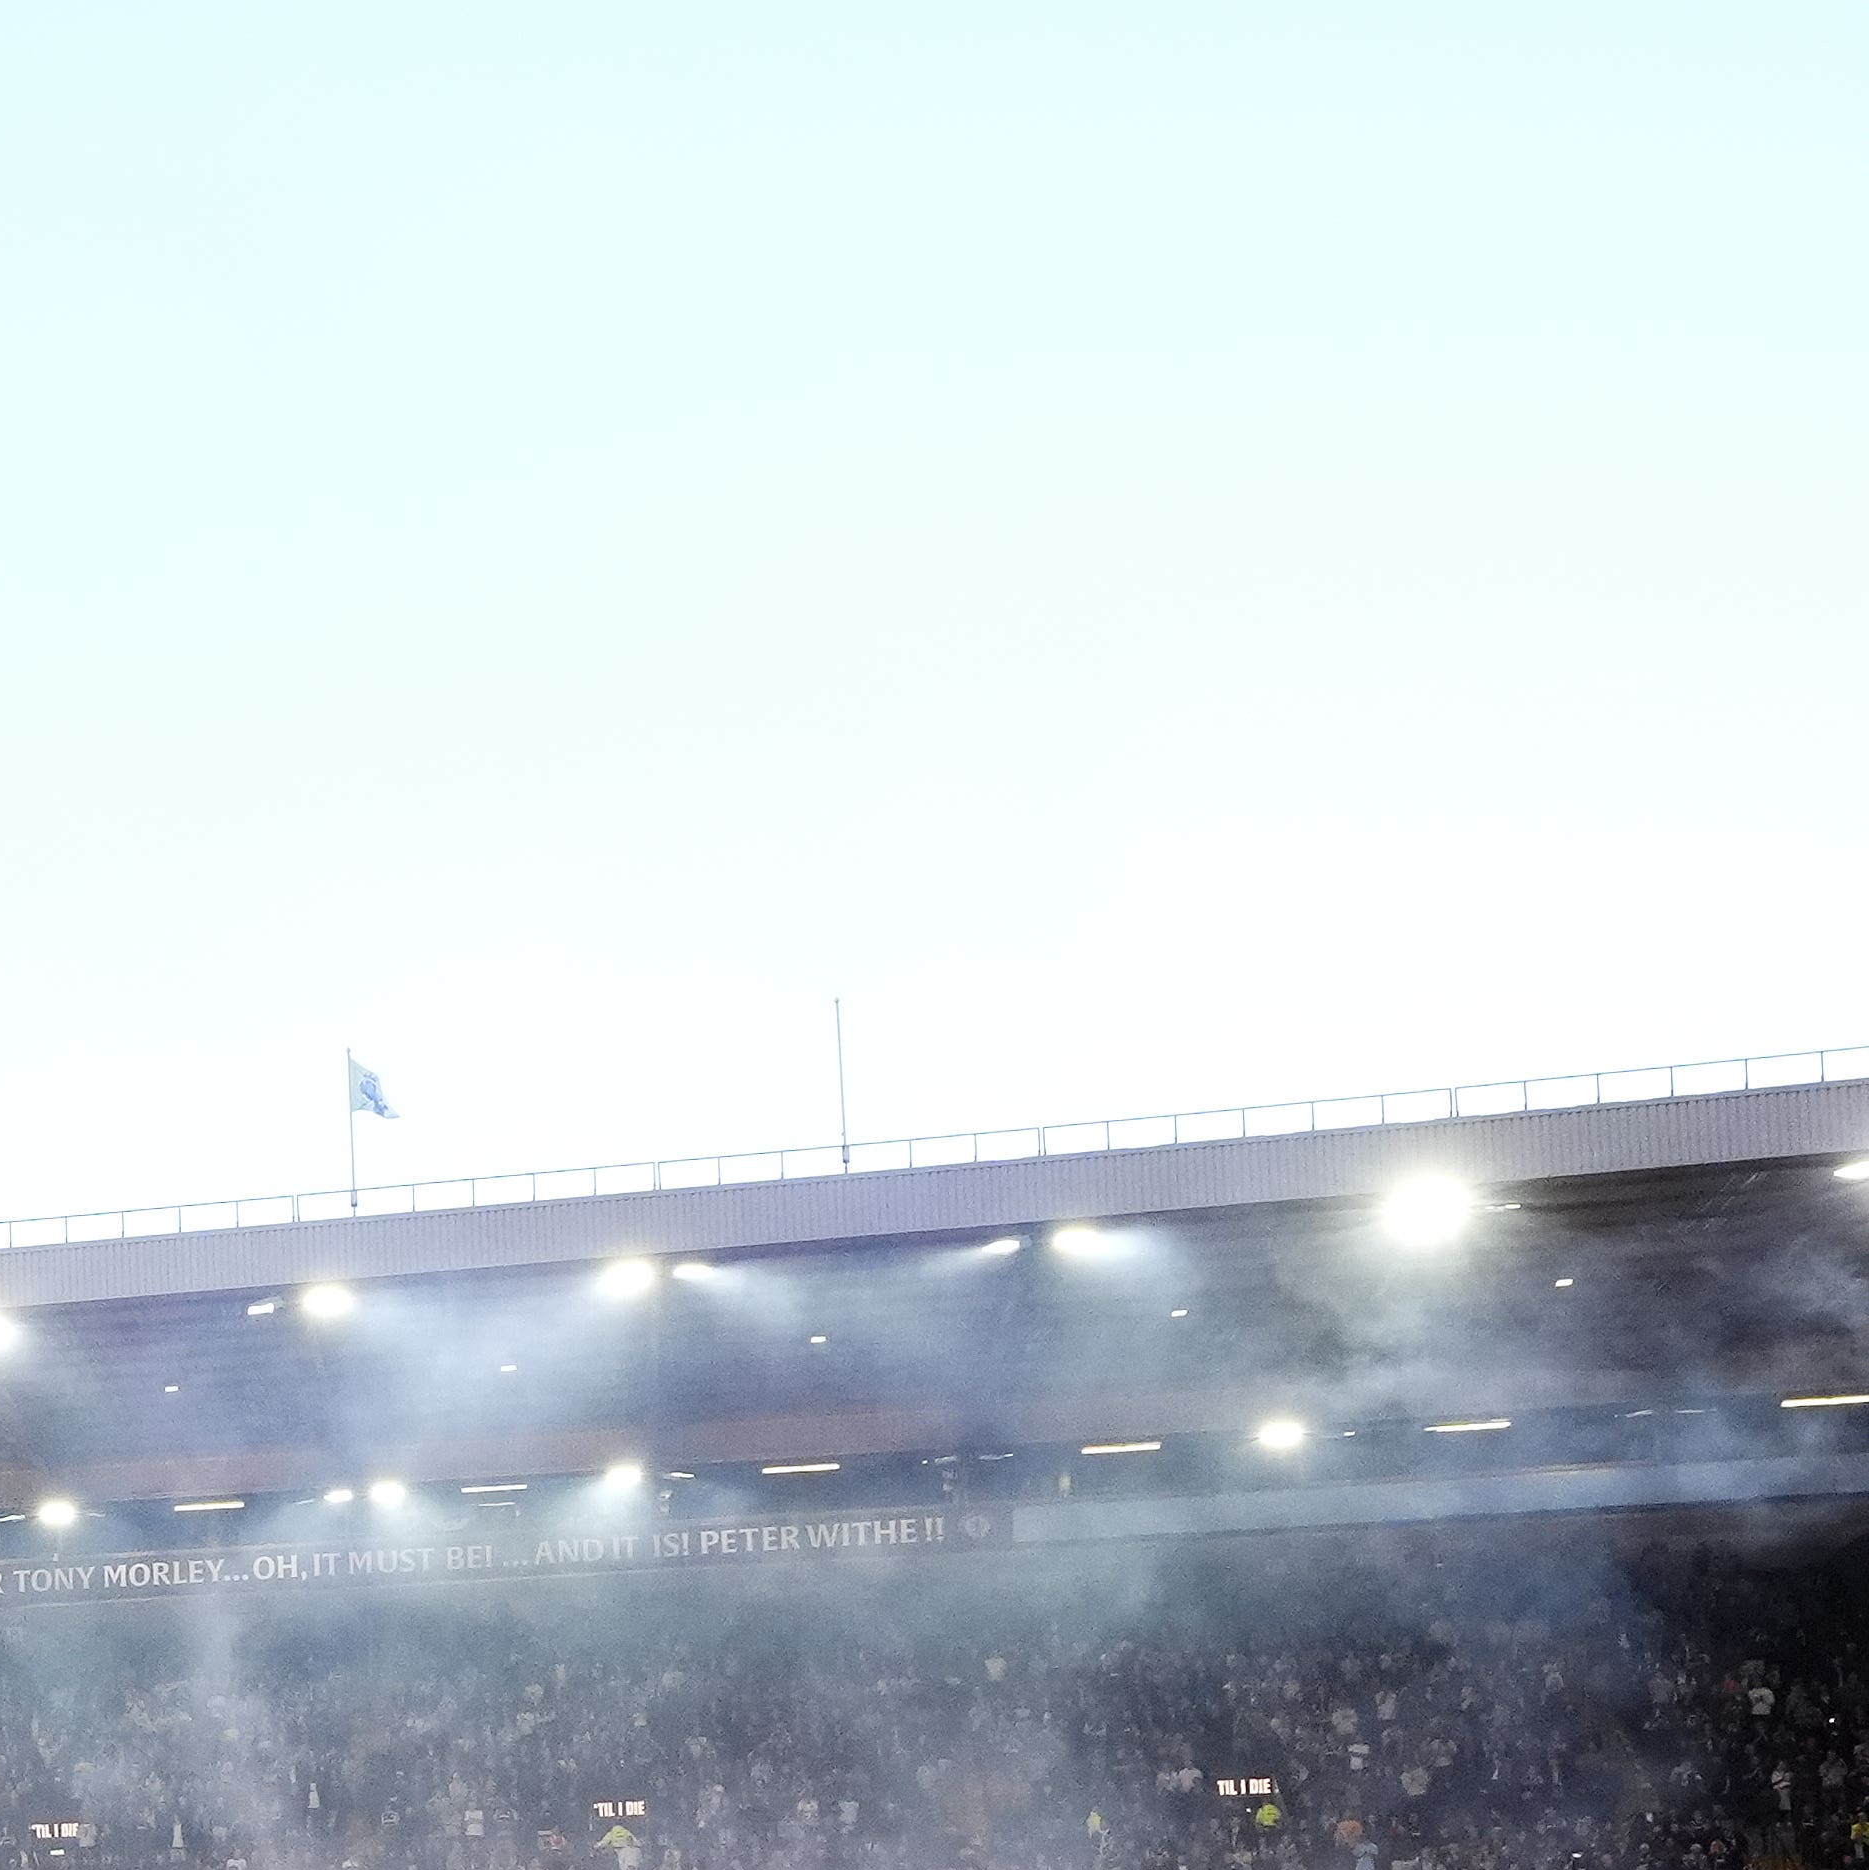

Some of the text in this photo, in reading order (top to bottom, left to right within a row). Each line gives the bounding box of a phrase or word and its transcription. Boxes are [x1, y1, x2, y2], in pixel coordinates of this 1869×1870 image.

[12, 1567, 95, 1593] TONY
[313, 1551, 342, 1577] IT
[348, 1546, 435, 1575] MUST
[445, 1543, 493, 1570] BE!
[613, 1534, 639, 1561] IT
[653, 1531, 691, 1558] IS!
[700, 1525, 802, 1556] PETER
[1240, 1779, 1246, 1795] I
[1249, 1778, 1272, 1795] DIE
[618, 1801, 623, 1817] I
[625, 1801, 645, 1817] DIE
